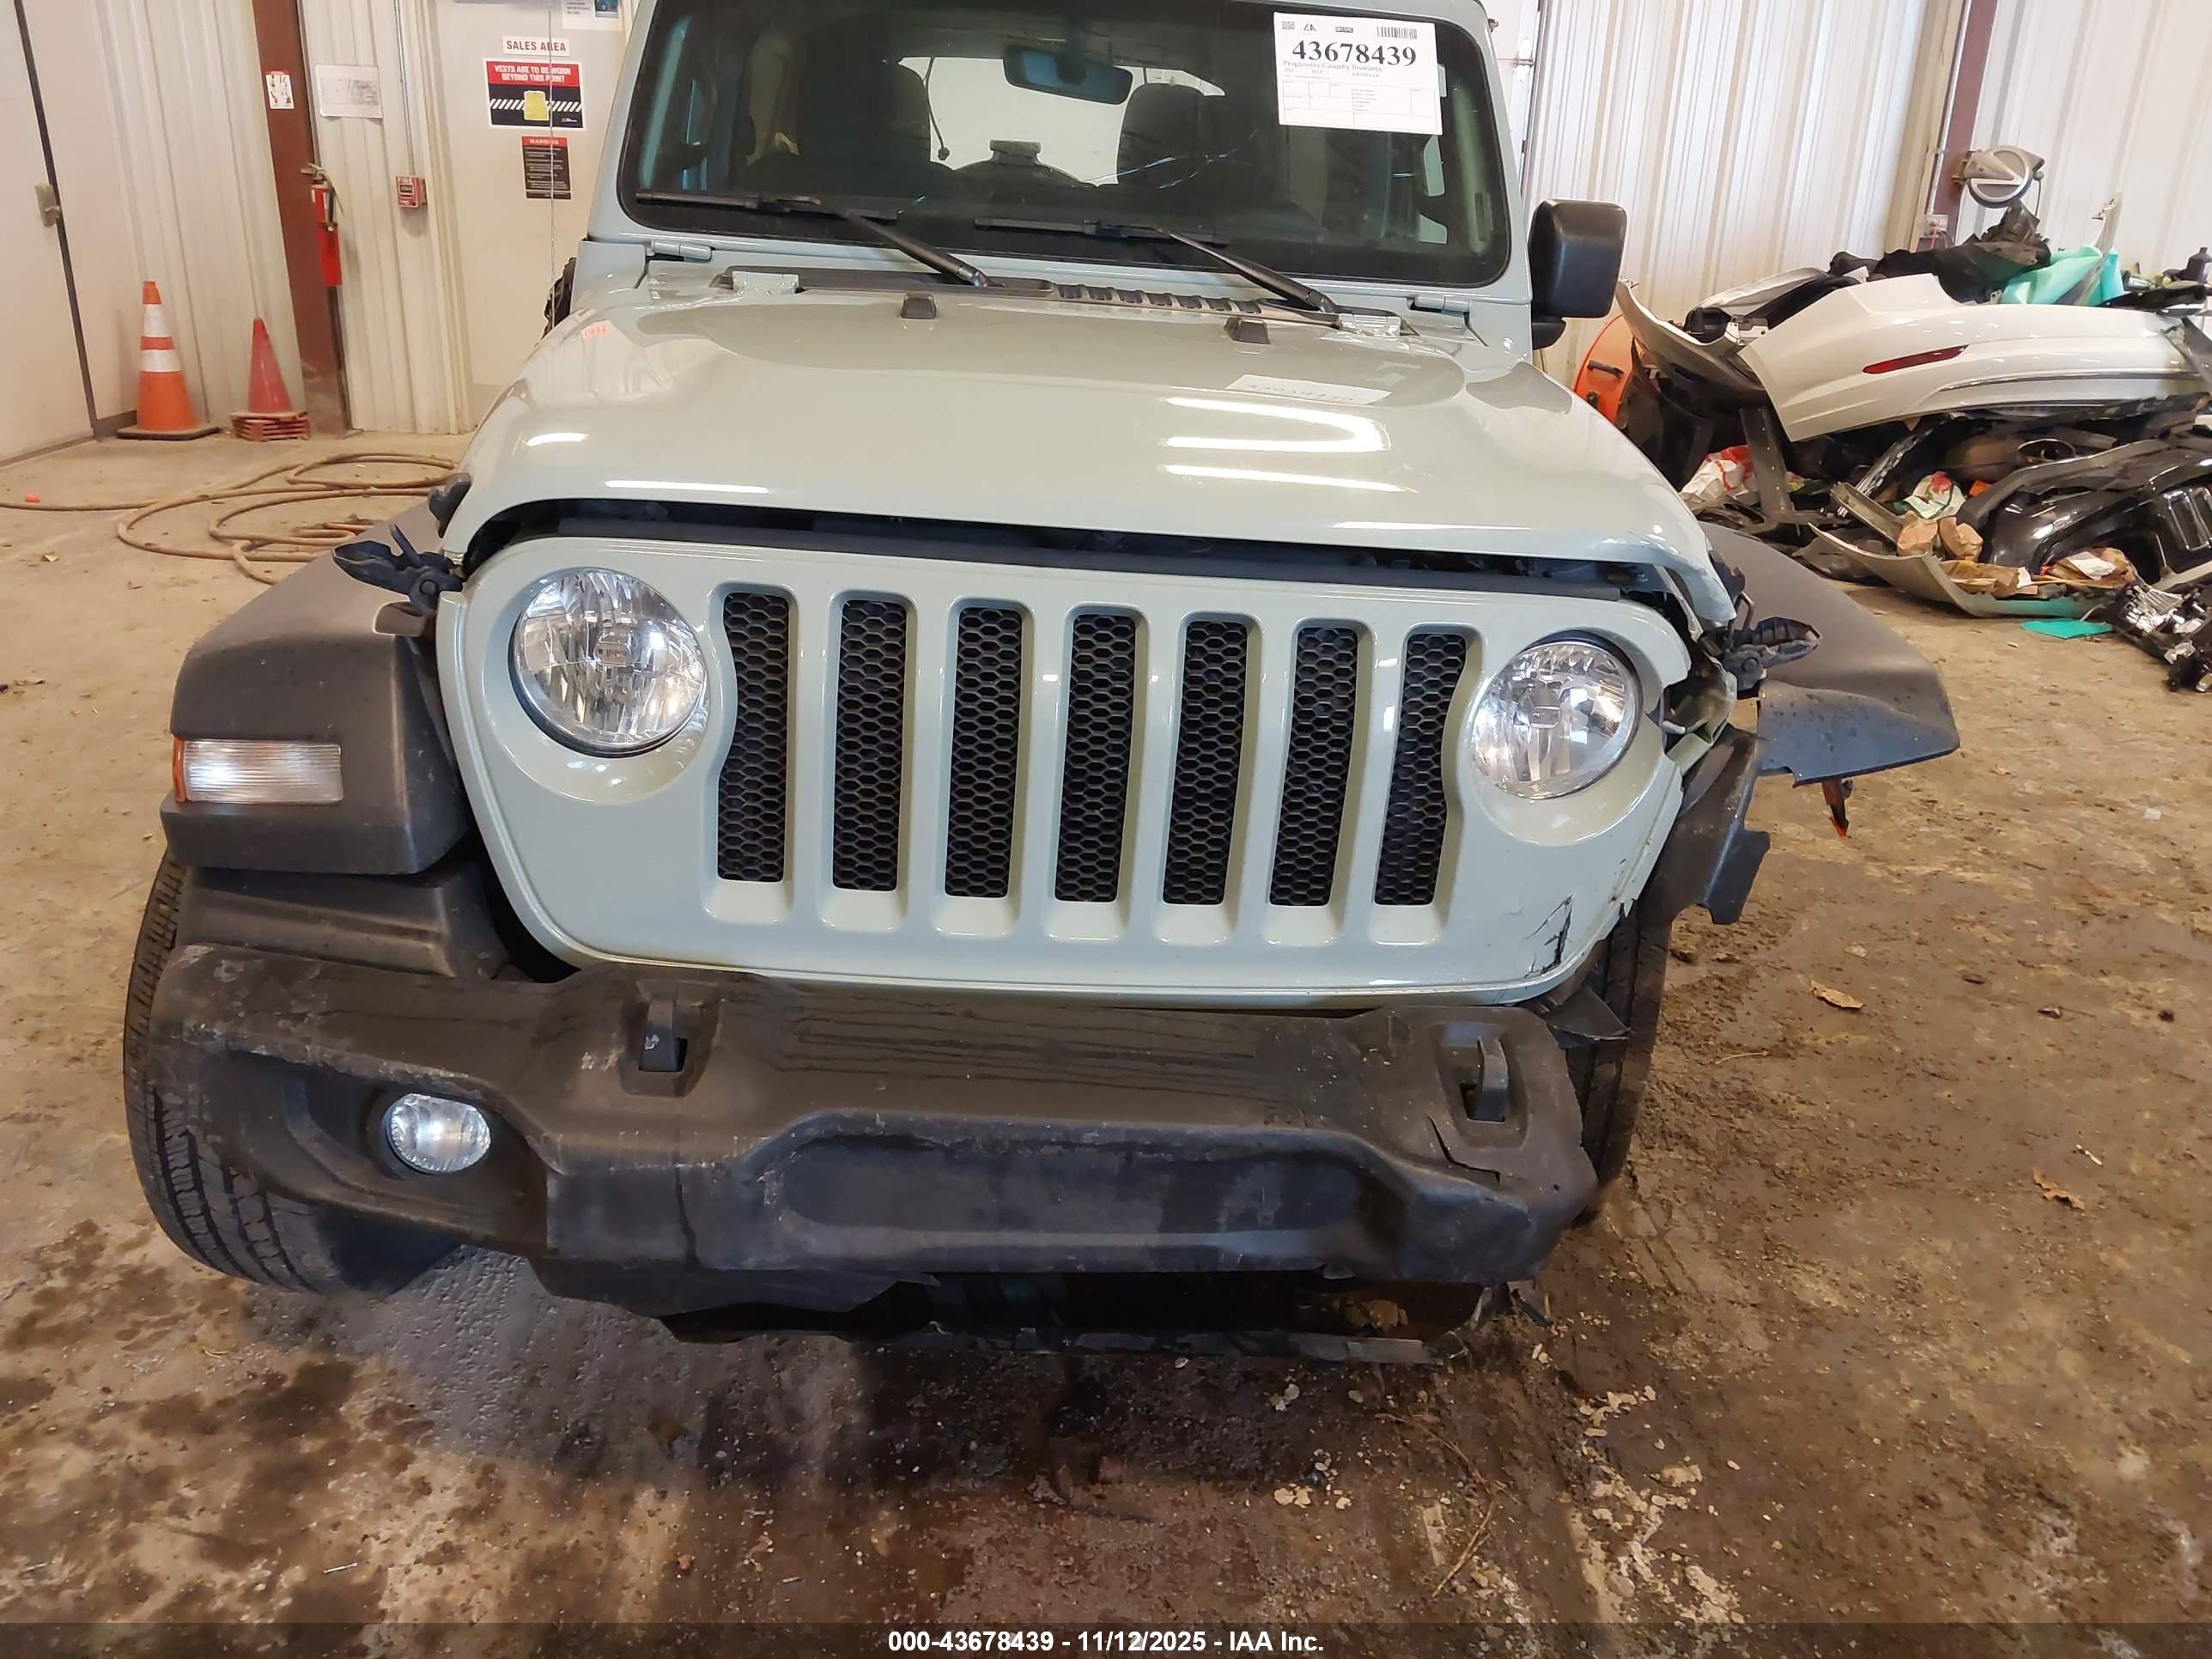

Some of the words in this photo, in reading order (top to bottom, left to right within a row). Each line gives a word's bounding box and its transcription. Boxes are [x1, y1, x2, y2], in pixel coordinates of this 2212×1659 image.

[507, 40, 537, 51] SALES
[540, 42, 566, 52] AREA
[1292, 40, 1416, 66] 43678439
[494, 64, 516, 73] VESTS
[550, 67, 571, 76] WORN
[1283, 60, 1320, 69] Progressive
[501, 73, 528, 82] BEYOND
